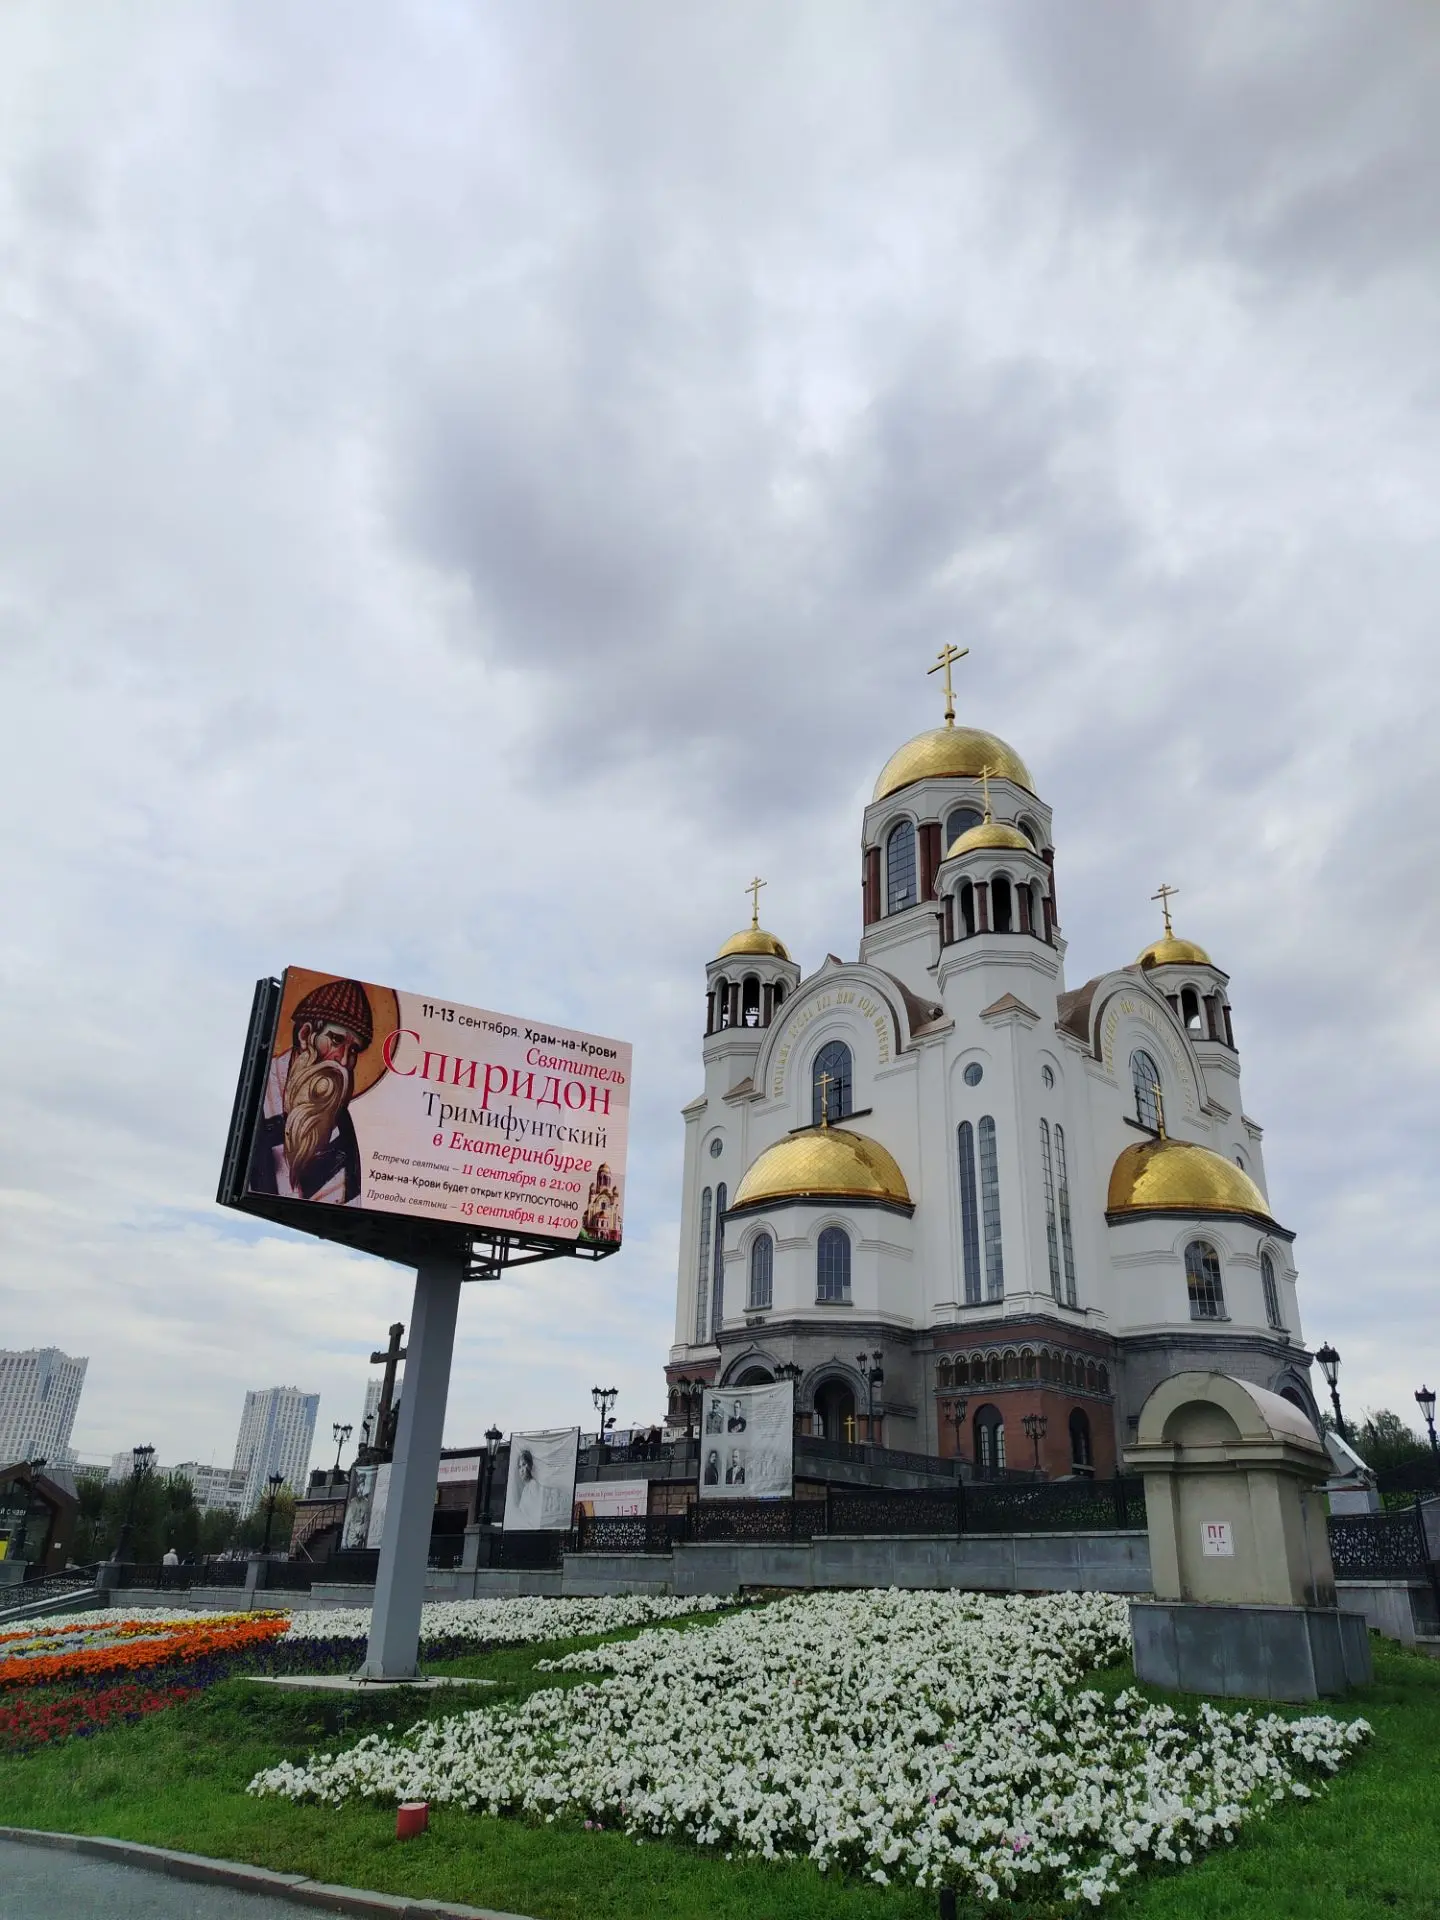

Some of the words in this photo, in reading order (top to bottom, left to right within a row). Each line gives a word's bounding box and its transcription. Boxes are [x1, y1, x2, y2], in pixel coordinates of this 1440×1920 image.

[422, 1004, 455, 1023] 11-13
[524, 1027, 617, 1060] Храм-на-Крови
[382, 1029, 612, 1115] Спиридон
[526, 1047, 625, 1085] Святитель
[422, 1091, 608, 1148] Тримифунтский
[372, 1151, 410, 1165] Встреча
[412, 1159, 450, 1172] святыни
[461, 1164, 473, 1175] 11
[476, 1167, 537, 1188] сентября
[539, 1177, 547, 1188] в
[549, 1179, 581, 1193] 21:00
[432, 1133, 443, 1146] в
[448, 1131, 592, 1173] Екатеринбурге
[366, 1189, 406, 1203] Проводы
[408, 1197, 448, 1210] святыни
[460, 1202, 474, 1216] 13
[476, 1205, 535, 1225] сентября
[537, 1215, 545, 1224] в
[547, 1215, 578, 1229] 14:00
[369, 1169, 441, 1188] Храм-на-Крови
[442, 1181, 469, 1194] будет
[470, 1187, 502, 1199] открыт
[504, 1190, 578, 1211] КРУГЛОСУТОЧНО
[1207, 1525, 1225, 1538] ПГ
